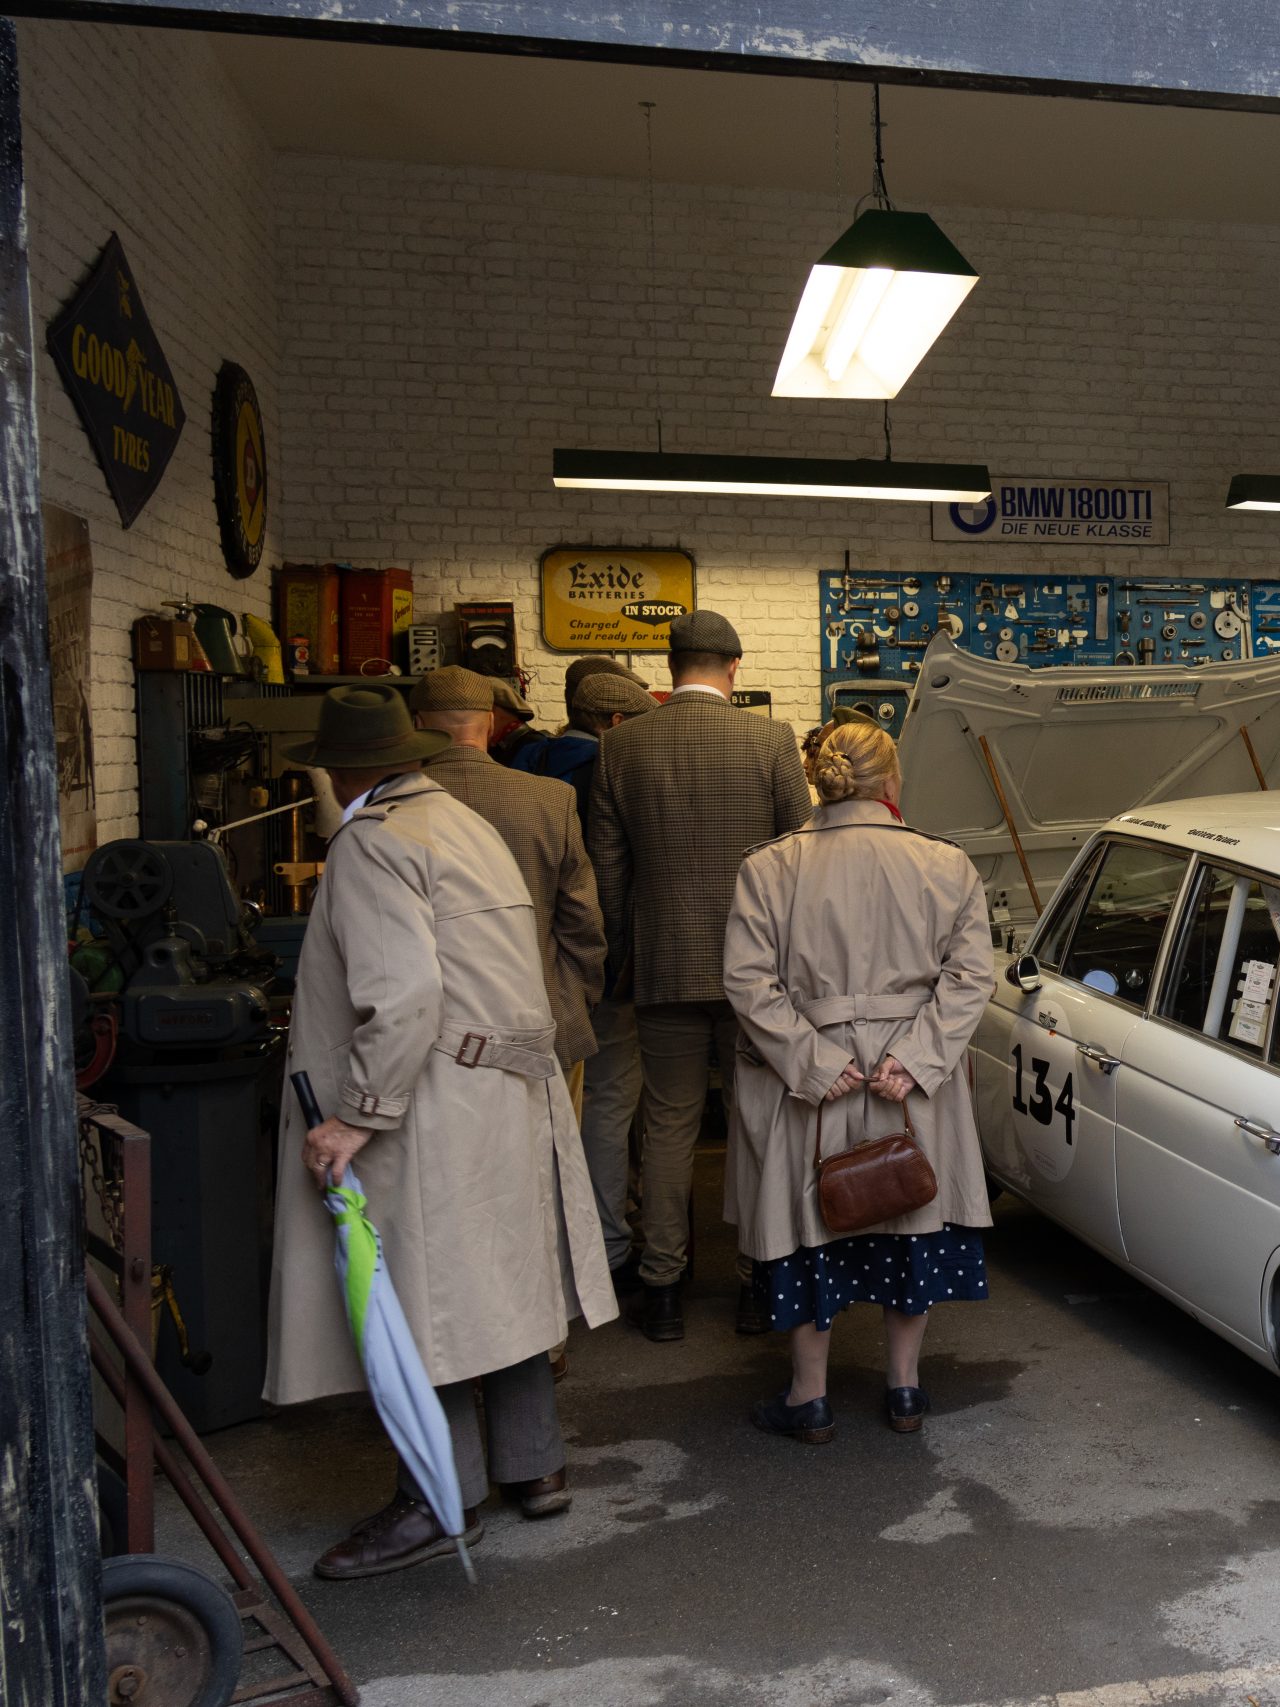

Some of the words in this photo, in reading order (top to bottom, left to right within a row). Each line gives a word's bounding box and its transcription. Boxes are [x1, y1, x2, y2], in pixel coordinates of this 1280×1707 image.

[112, 424, 150, 473] TYRES
[1001, 486, 1065, 518] BMW
[1001, 522, 1028, 535] DIE
[1034, 523, 1081, 536] NEUE
[1086, 524, 1153, 538] KLASSE
[568, 562, 645, 589] Exide
[568, 590, 645, 599] BATTERIES
[625, 605, 639, 616] IN
[642, 605, 683, 616] STOCK
[569, 619, 621, 631] Charged
[569, 632, 592, 641] and
[594, 632, 628, 643] ready
[631, 631, 649, 641] for
[1011, 1043, 1076, 1146] 134
